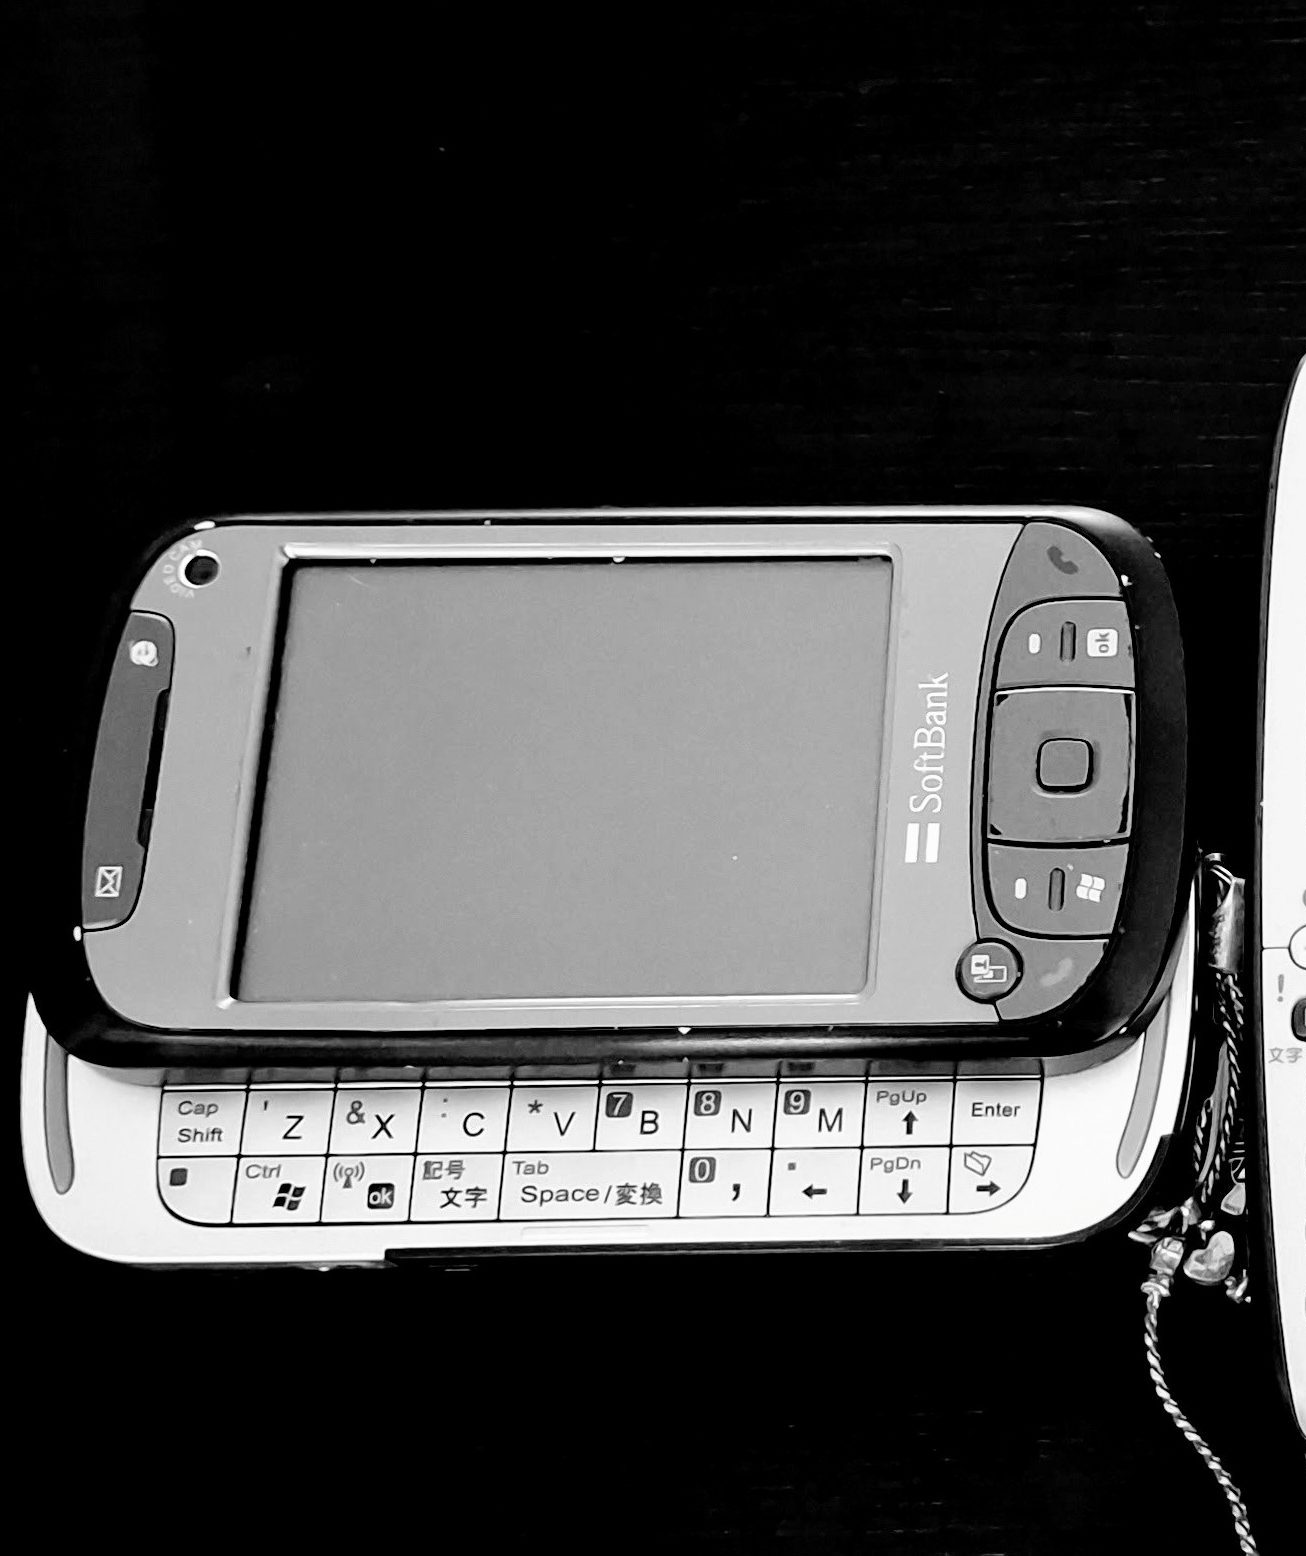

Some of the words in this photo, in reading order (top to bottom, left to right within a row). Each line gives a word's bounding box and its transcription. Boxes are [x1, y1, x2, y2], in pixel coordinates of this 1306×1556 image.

[1095, 632, 1111, 654] ok
[909, 672, 949, 813] SoftBank
[1268, 1047, 1303, 1063] 文字
[608, 1094, 629, 1115] 7
[699, 1093, 717, 1114] 8
[788, 1091, 806, 1113] 9
[876, 1089, 927, 1106] PgUp
[177, 1101, 218, 1117] Cap
[971, 1102, 1021, 1118] Enter
[282, 1116, 304, 1140] Z
[371, 1114, 396, 1139] X
[463, 1112, 485, 1137] C
[553, 1112, 575, 1136] V
[640, 1110, 659, 1134] B
[731, 1108, 752, 1133] N
[817, 1108, 844, 1132] M
[177, 1127, 223, 1143] Shift
[245, 1164, 281, 1179] Ctrl
[423, 1160, 465, 1180] 記号
[512, 1161, 549, 1175] Tab
[870, 1156, 921, 1173] PgDn
[370, 1187, 392, 1205] ok
[440, 1186, 487, 1208] 文字
